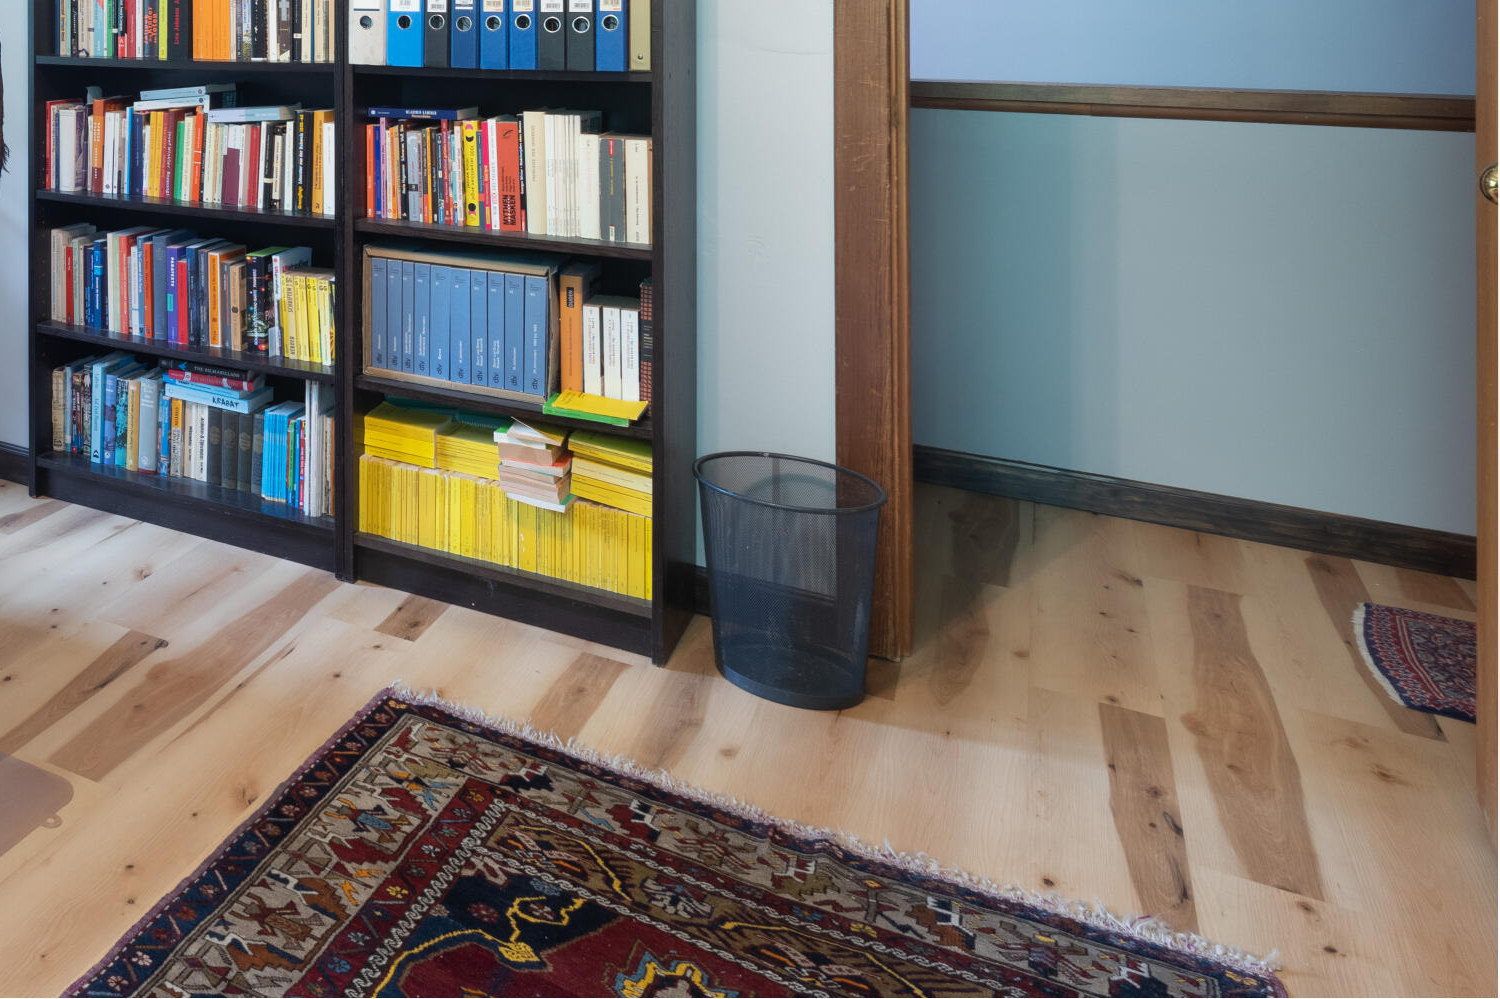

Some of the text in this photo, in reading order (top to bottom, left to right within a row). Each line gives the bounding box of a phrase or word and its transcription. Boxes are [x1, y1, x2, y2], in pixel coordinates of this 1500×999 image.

[509, 194, 517, 226] MASKEN
[204, 367, 240, 378] SILMARILLION
[212, 396, 240, 409] KRABAT
